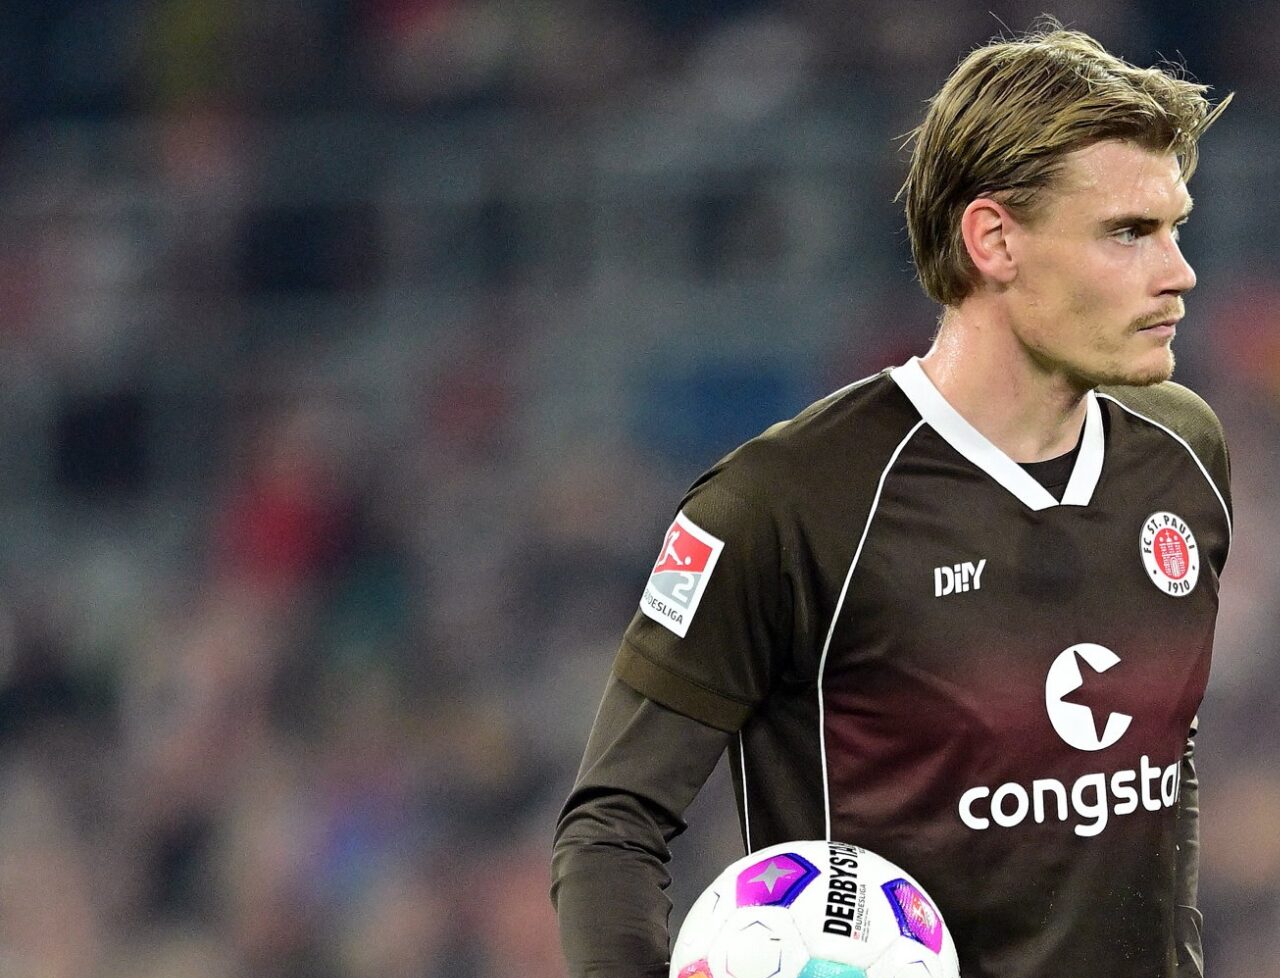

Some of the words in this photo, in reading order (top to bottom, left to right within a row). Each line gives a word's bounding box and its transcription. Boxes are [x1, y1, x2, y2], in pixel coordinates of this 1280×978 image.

[1147, 518, 1162, 535] ST.
[1163, 514, 1195, 550] PAULI
[1143, 537, 1152, 554] FC
[1167, 580, 1190, 594] 1910
[958, 754, 1181, 837] congsta
[854, 883, 867, 931] BUNDESLIGA
